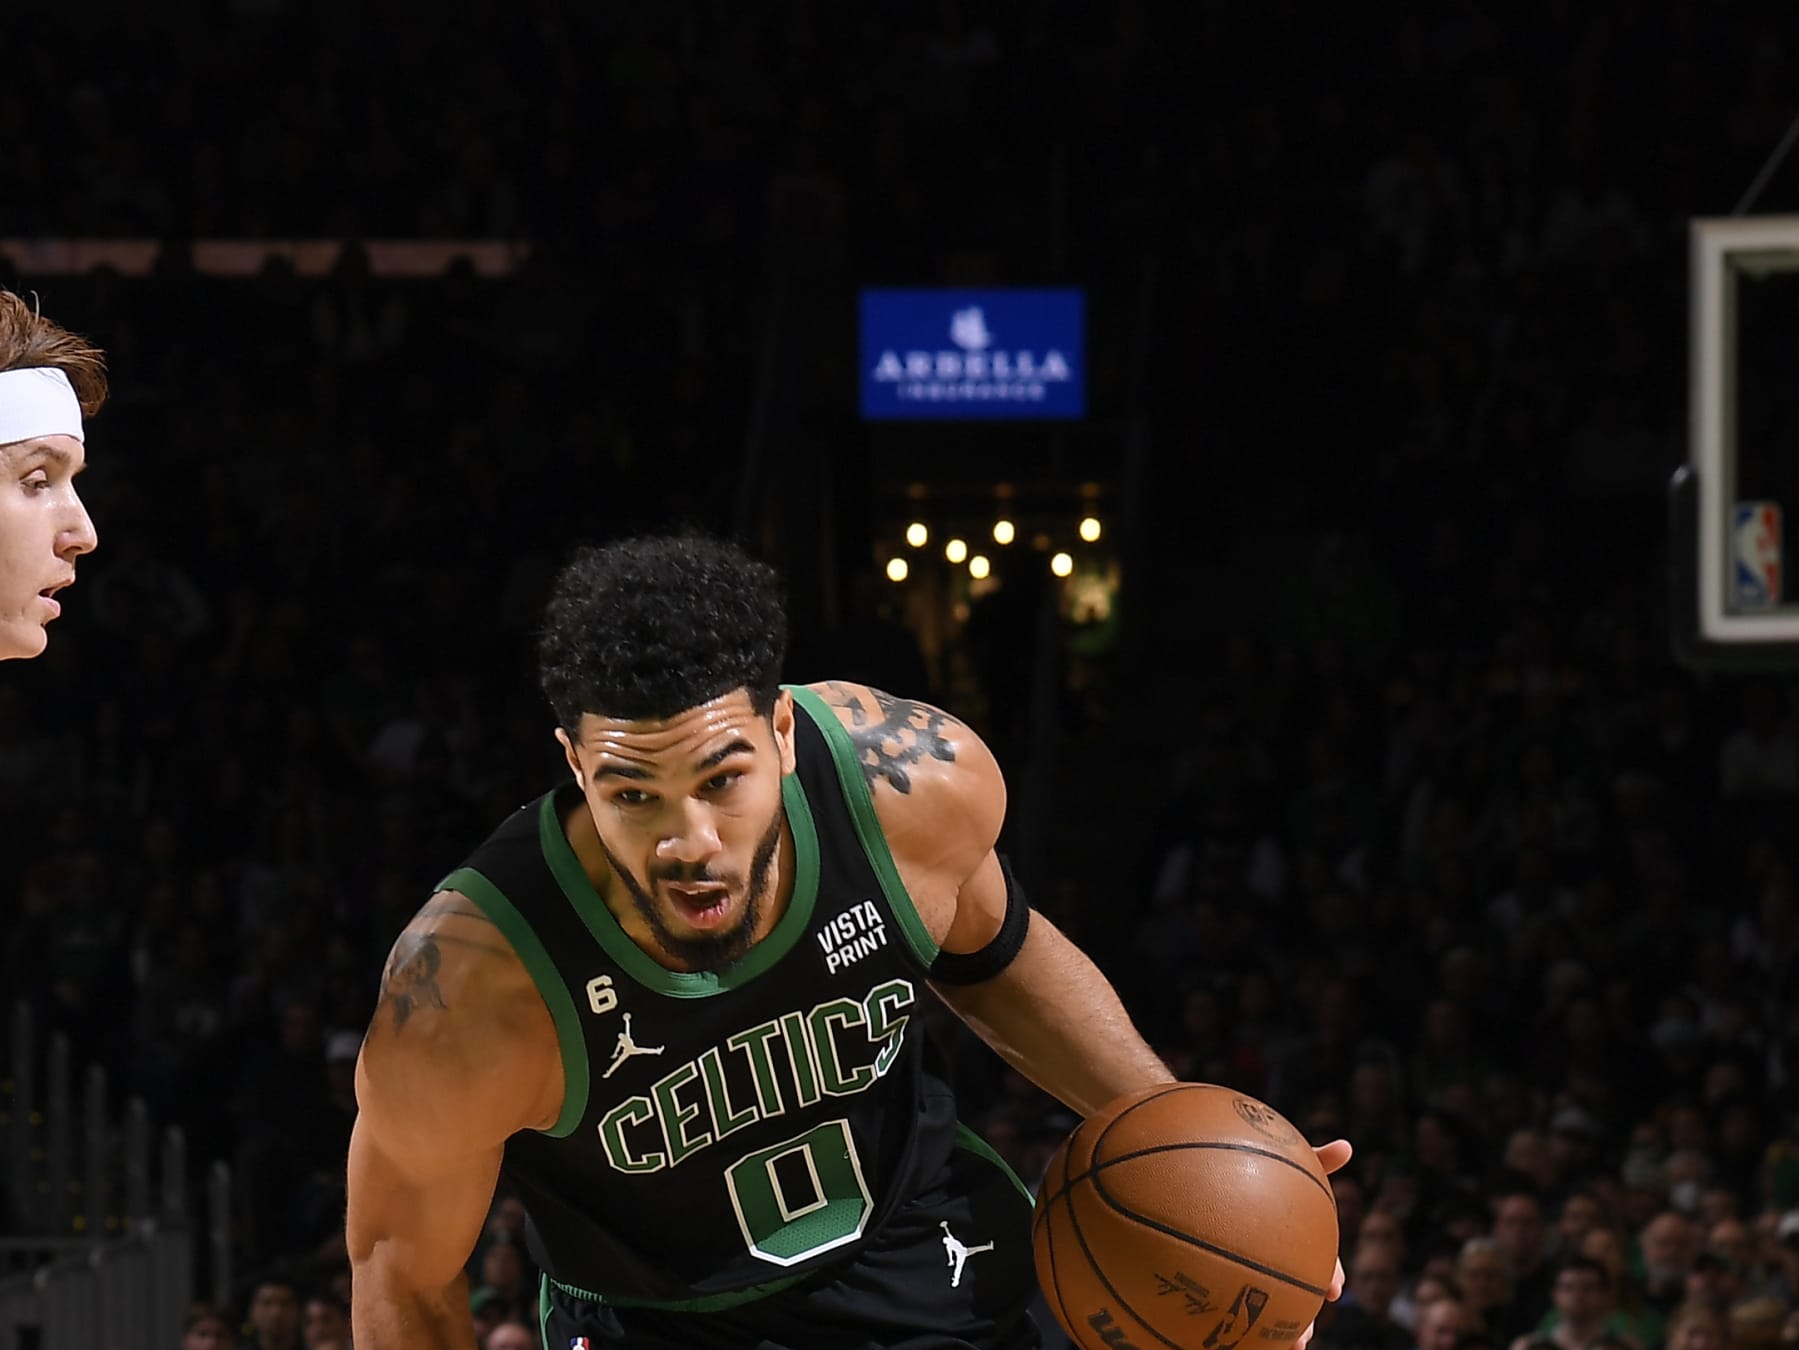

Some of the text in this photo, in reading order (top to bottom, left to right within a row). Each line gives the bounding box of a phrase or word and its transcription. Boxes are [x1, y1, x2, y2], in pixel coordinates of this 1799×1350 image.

[817, 900, 883, 954] VISTA
[825, 924, 888, 975] PRINT
[586, 974, 618, 1014] 6
[598, 978, 914, 1174] CELTICS
[723, 1118, 877, 1267] 0
